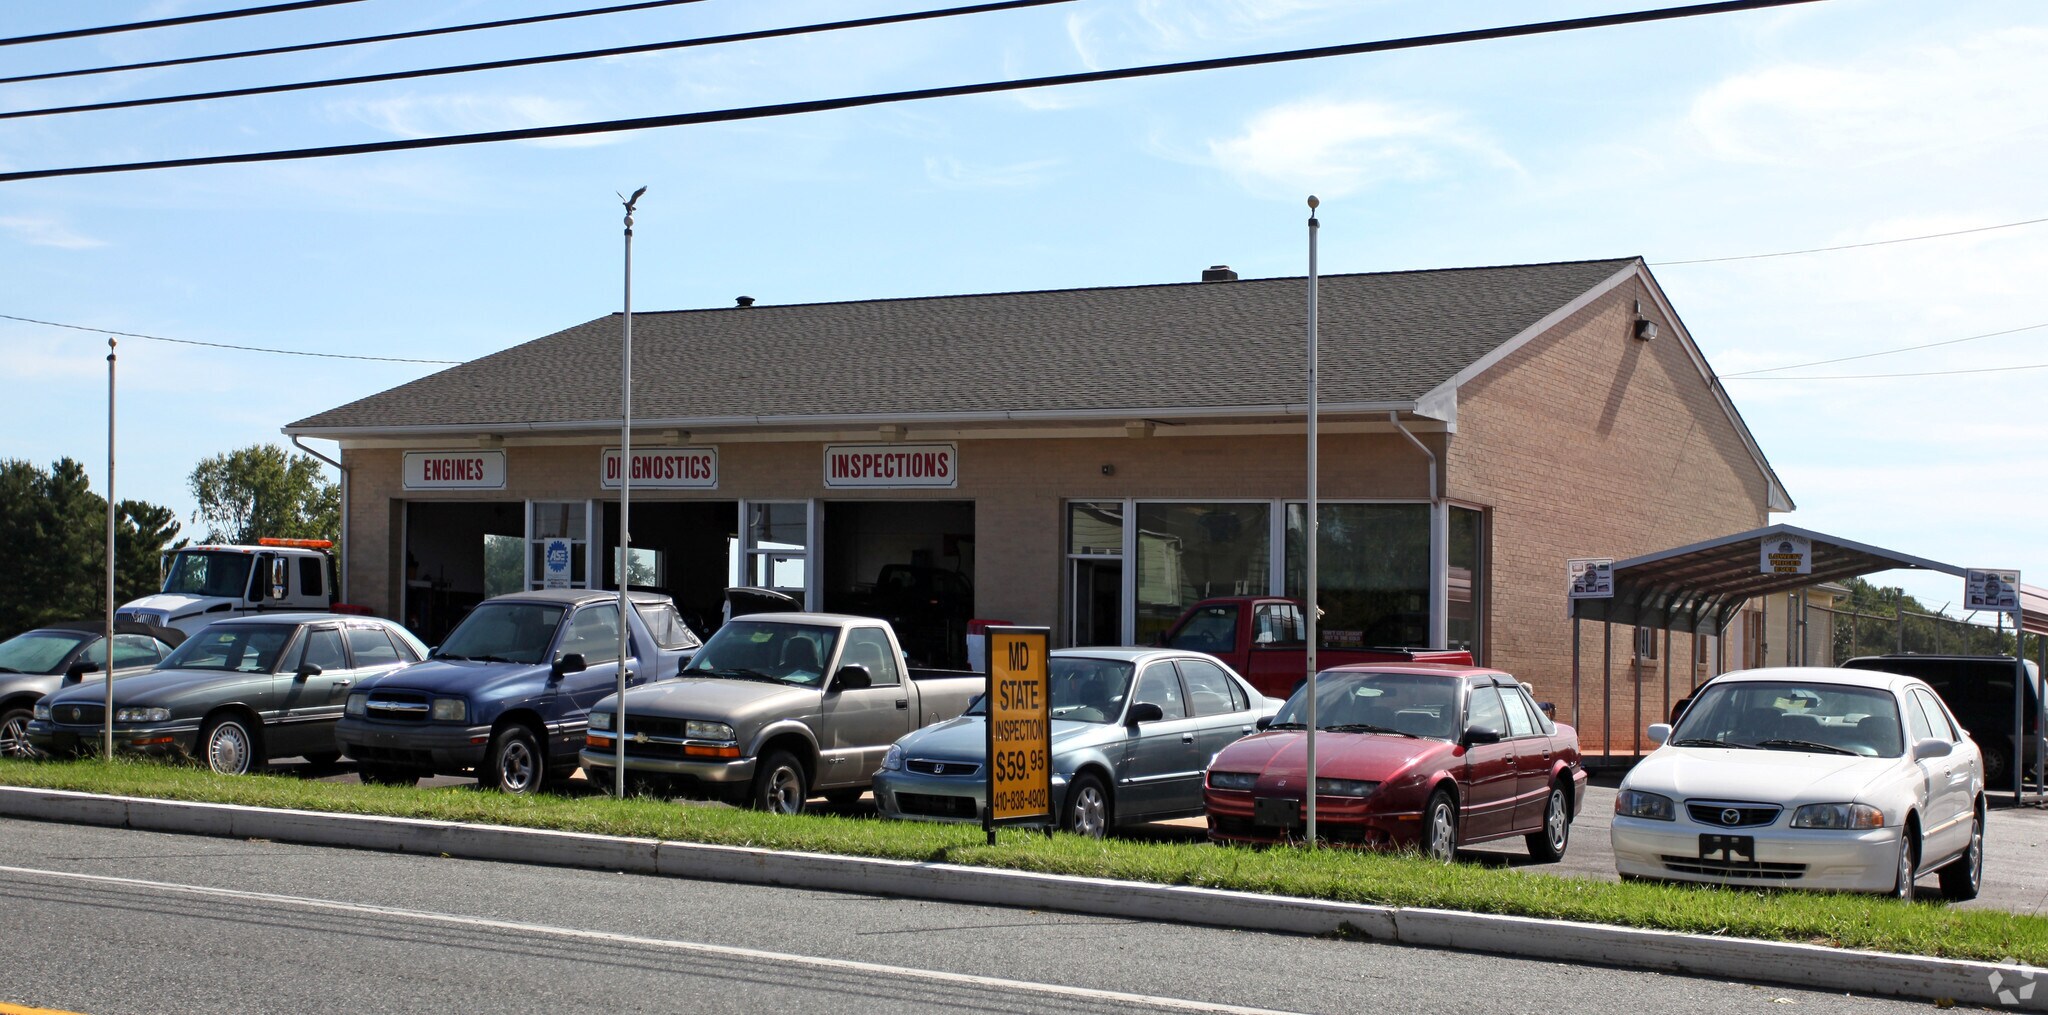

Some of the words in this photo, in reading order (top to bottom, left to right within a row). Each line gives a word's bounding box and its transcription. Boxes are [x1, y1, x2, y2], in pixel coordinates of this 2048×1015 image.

[424, 459, 483, 481] ENGINES
[607, 456, 711, 479] DIGNOSTICS
[832, 453, 948, 478] INSPECTIONS
[550, 550, 565, 560] ASE
[1009, 642, 1029, 671] MD
[1000, 680, 1038, 710] STATE
[995, 719, 1044, 741] INSPECTION
[996, 749, 1044, 785] $59.95
[995, 788, 1046, 811] 410-838-4902
